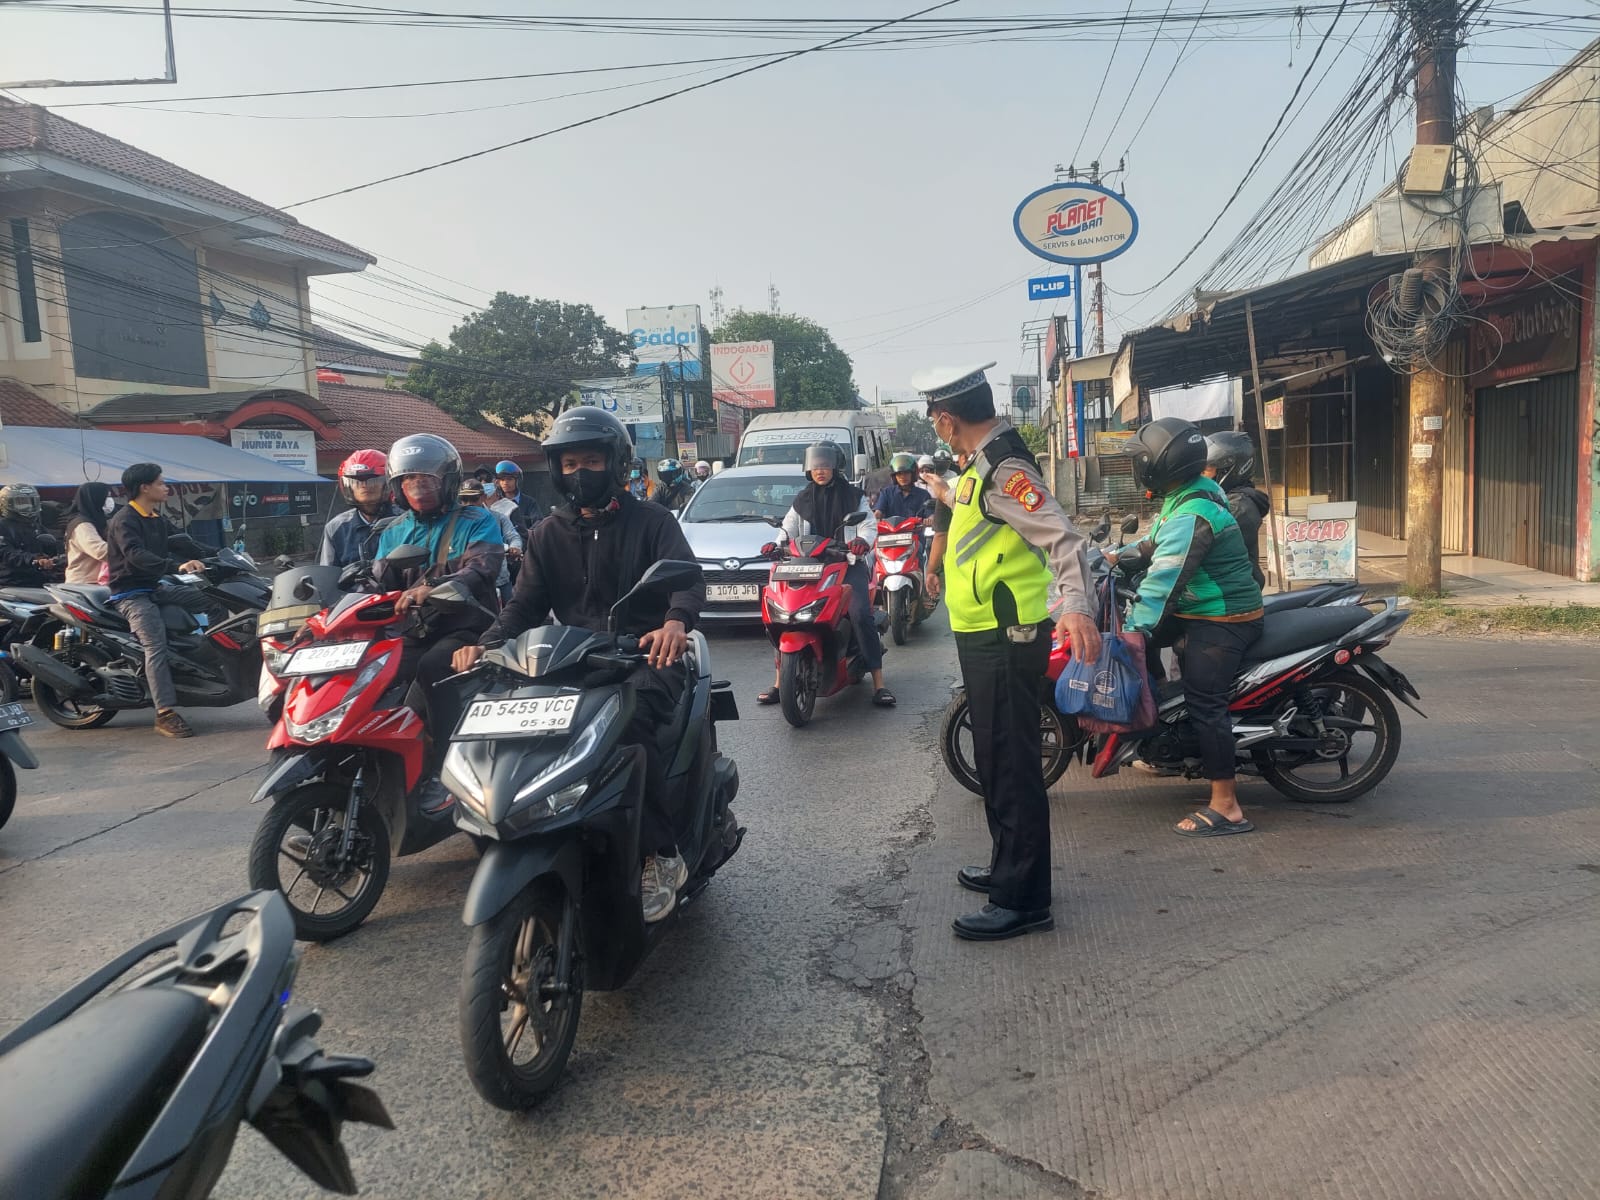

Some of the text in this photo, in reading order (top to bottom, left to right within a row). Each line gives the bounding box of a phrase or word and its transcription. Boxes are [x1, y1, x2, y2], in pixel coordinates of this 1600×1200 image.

[1046, 196, 1107, 234] PLANET
[1081, 217, 1103, 232] BAN
[1043, 240, 1069, 250] SERVIS
[1077, 237, 1094, 246] BAN
[1095, 233, 1126, 243] MOTOR
[1032, 281, 1065, 294] PLUS
[629, 324, 697, 349] Gadai
[712, 344, 769, 356] INDOGADAI
[258, 431, 283, 440] TOKO
[1286, 520, 1349, 542] SEGAR
[706, 585, 757, 596] B 1070 JFB
[308, 647, 340, 660] 2267
[469, 699, 575, 718] AD 5459 VCC
